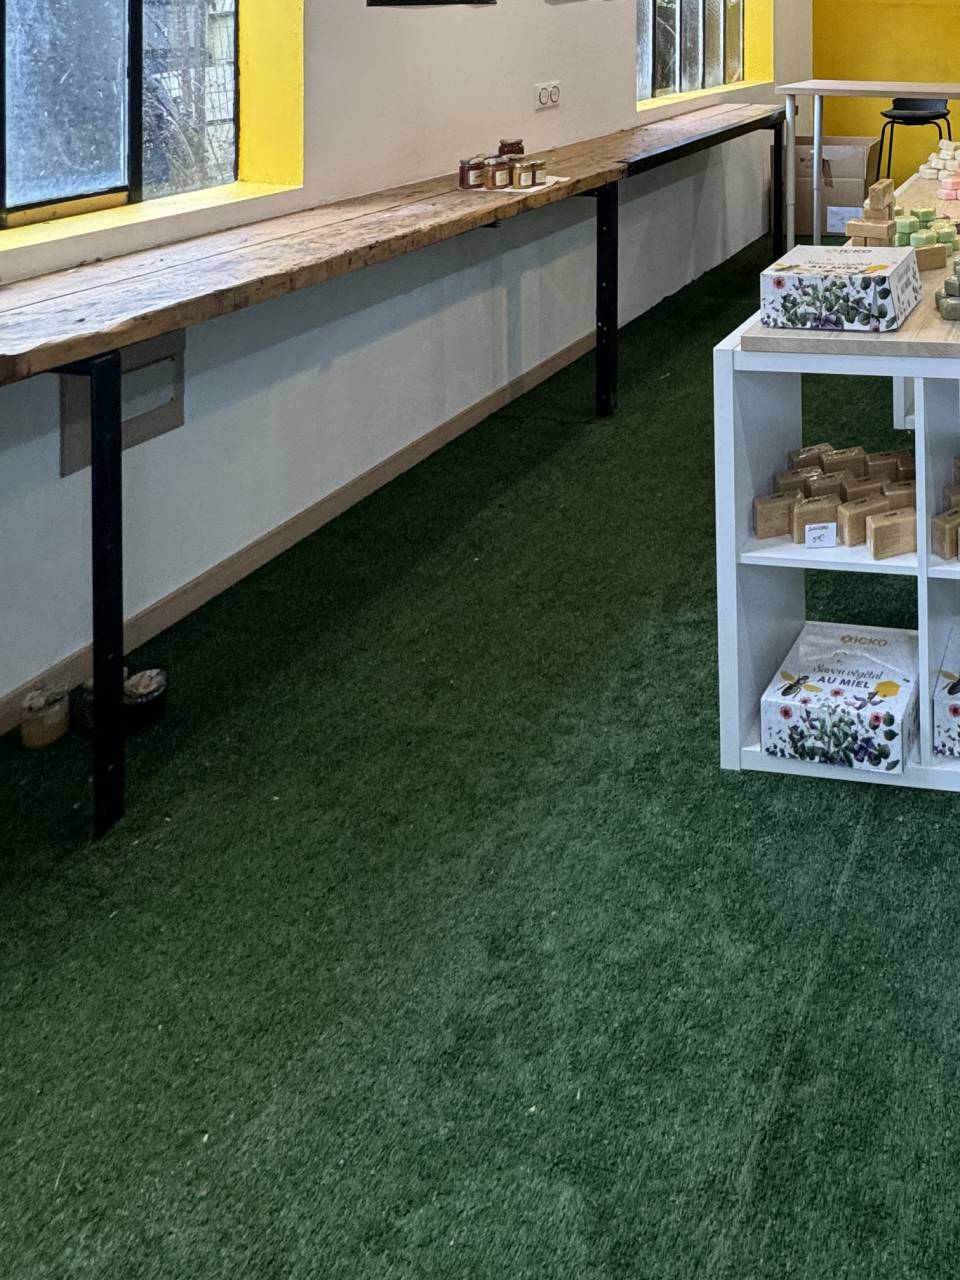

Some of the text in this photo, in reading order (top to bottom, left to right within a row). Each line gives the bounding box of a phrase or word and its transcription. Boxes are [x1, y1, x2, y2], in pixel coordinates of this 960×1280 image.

[855, 635, 888, 647] ICKO
[812, 663, 884, 681] Savon végétal
[816, 676, 870, 689] AU MIEL
